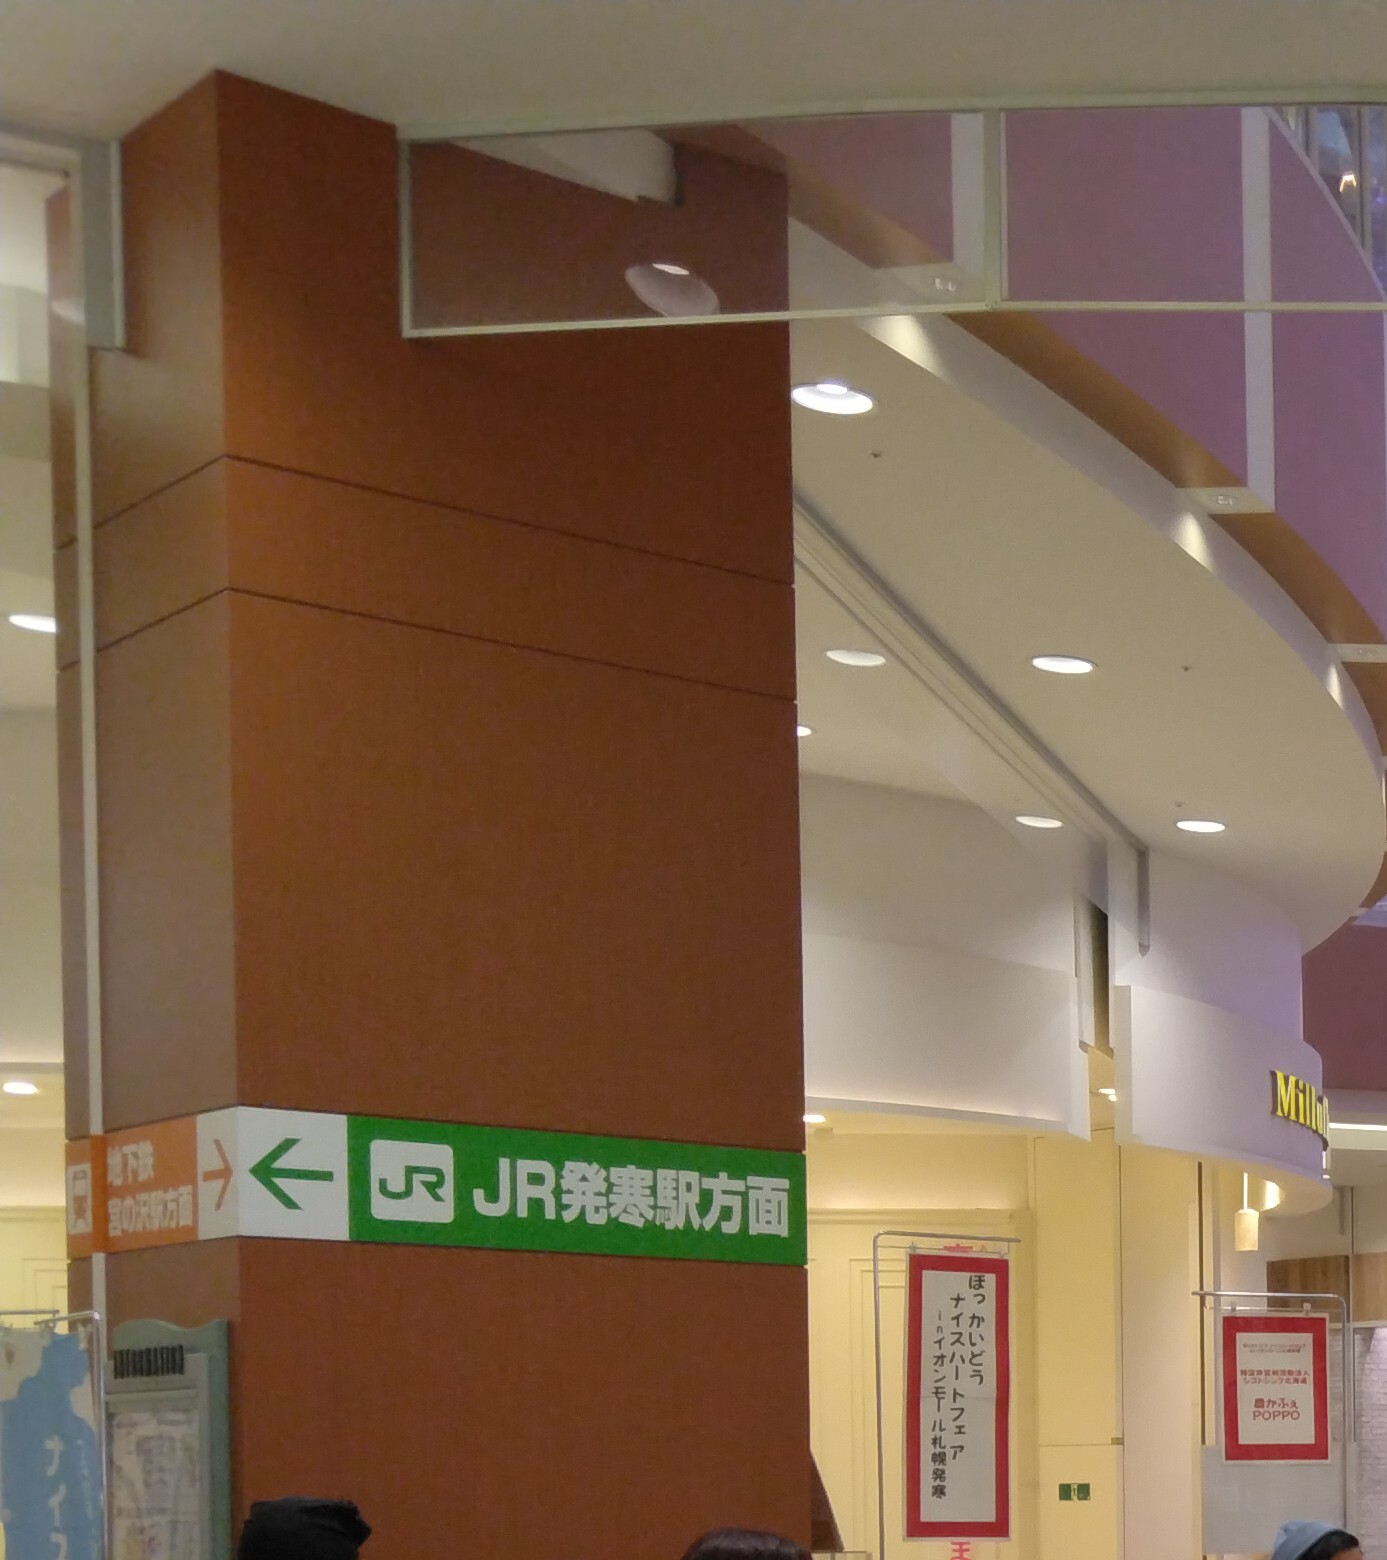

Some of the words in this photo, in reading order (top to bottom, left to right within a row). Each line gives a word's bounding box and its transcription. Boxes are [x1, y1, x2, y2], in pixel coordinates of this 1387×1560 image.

[473, 1156, 790, 1238] JR発寒駅方面
[950, 1292, 966, 1461] ナイスハートフェア
[968, 1274, 986, 1386] ほっかいどう
[1252, 1410, 1300, 1421] POPPO
